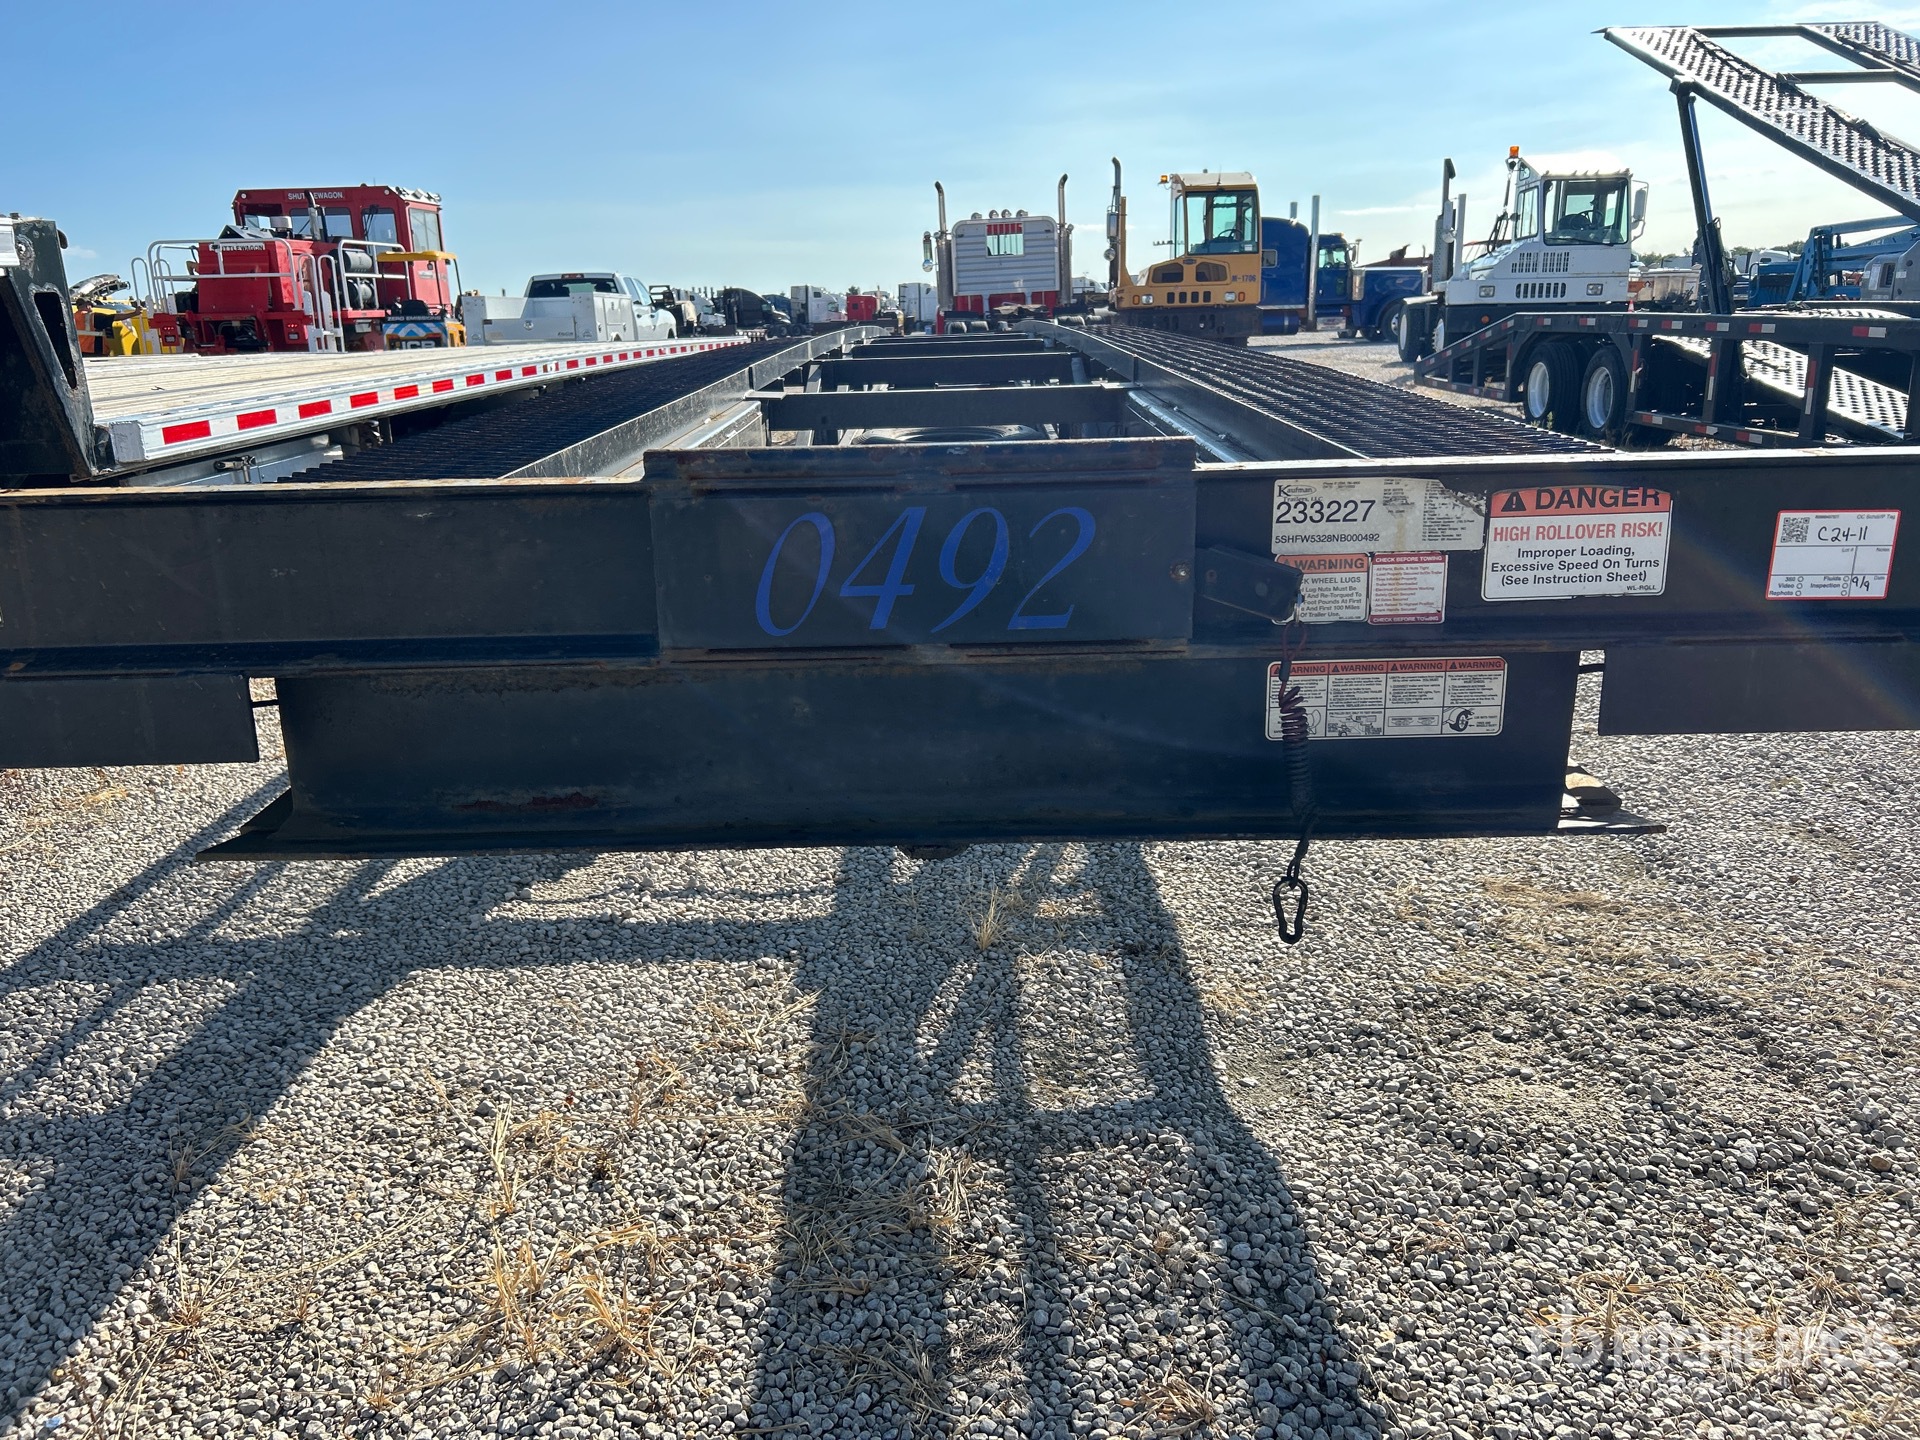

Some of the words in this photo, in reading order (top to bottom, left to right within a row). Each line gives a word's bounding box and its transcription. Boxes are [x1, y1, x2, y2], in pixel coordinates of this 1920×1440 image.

[288, 191, 343, 200] SHUTEWAGON
[1277, 485, 1313, 497] Kaufman
[1535, 487, 1661, 509] DANGER
[1275, 499, 1376, 524] 233227
[1274, 533, 1380, 544] 5SHFW5328NB000492
[1493, 526, 1530, 542] HIGH
[1535, 523, 1616, 540] ROLLOVER
[1621, 522, 1663, 538] RISK!
[1517, 547, 1577, 560] Improper
[1580, 545, 1635, 559] Loading,
[755, 506, 1096, 636] 0492
[1294, 558, 1365, 570] WARNING
[1491, 561, 1554, 573] Excessive
[1558, 559, 1598, 572] Speed
[1602, 559, 1620, 569] On
[1625, 558, 1660, 568] Turns
[1501, 575, 1529, 586] (See
[1533, 572, 1602, 584] Instruction
[1606, 570, 1647, 583] Sheet)
[1851, 576, 1870, 592] 9/9
[1291, 666, 1326, 674] ARNING
[1340, 664, 1384, 672] WARNING
[1458, 661, 1501, 669] WARNING
